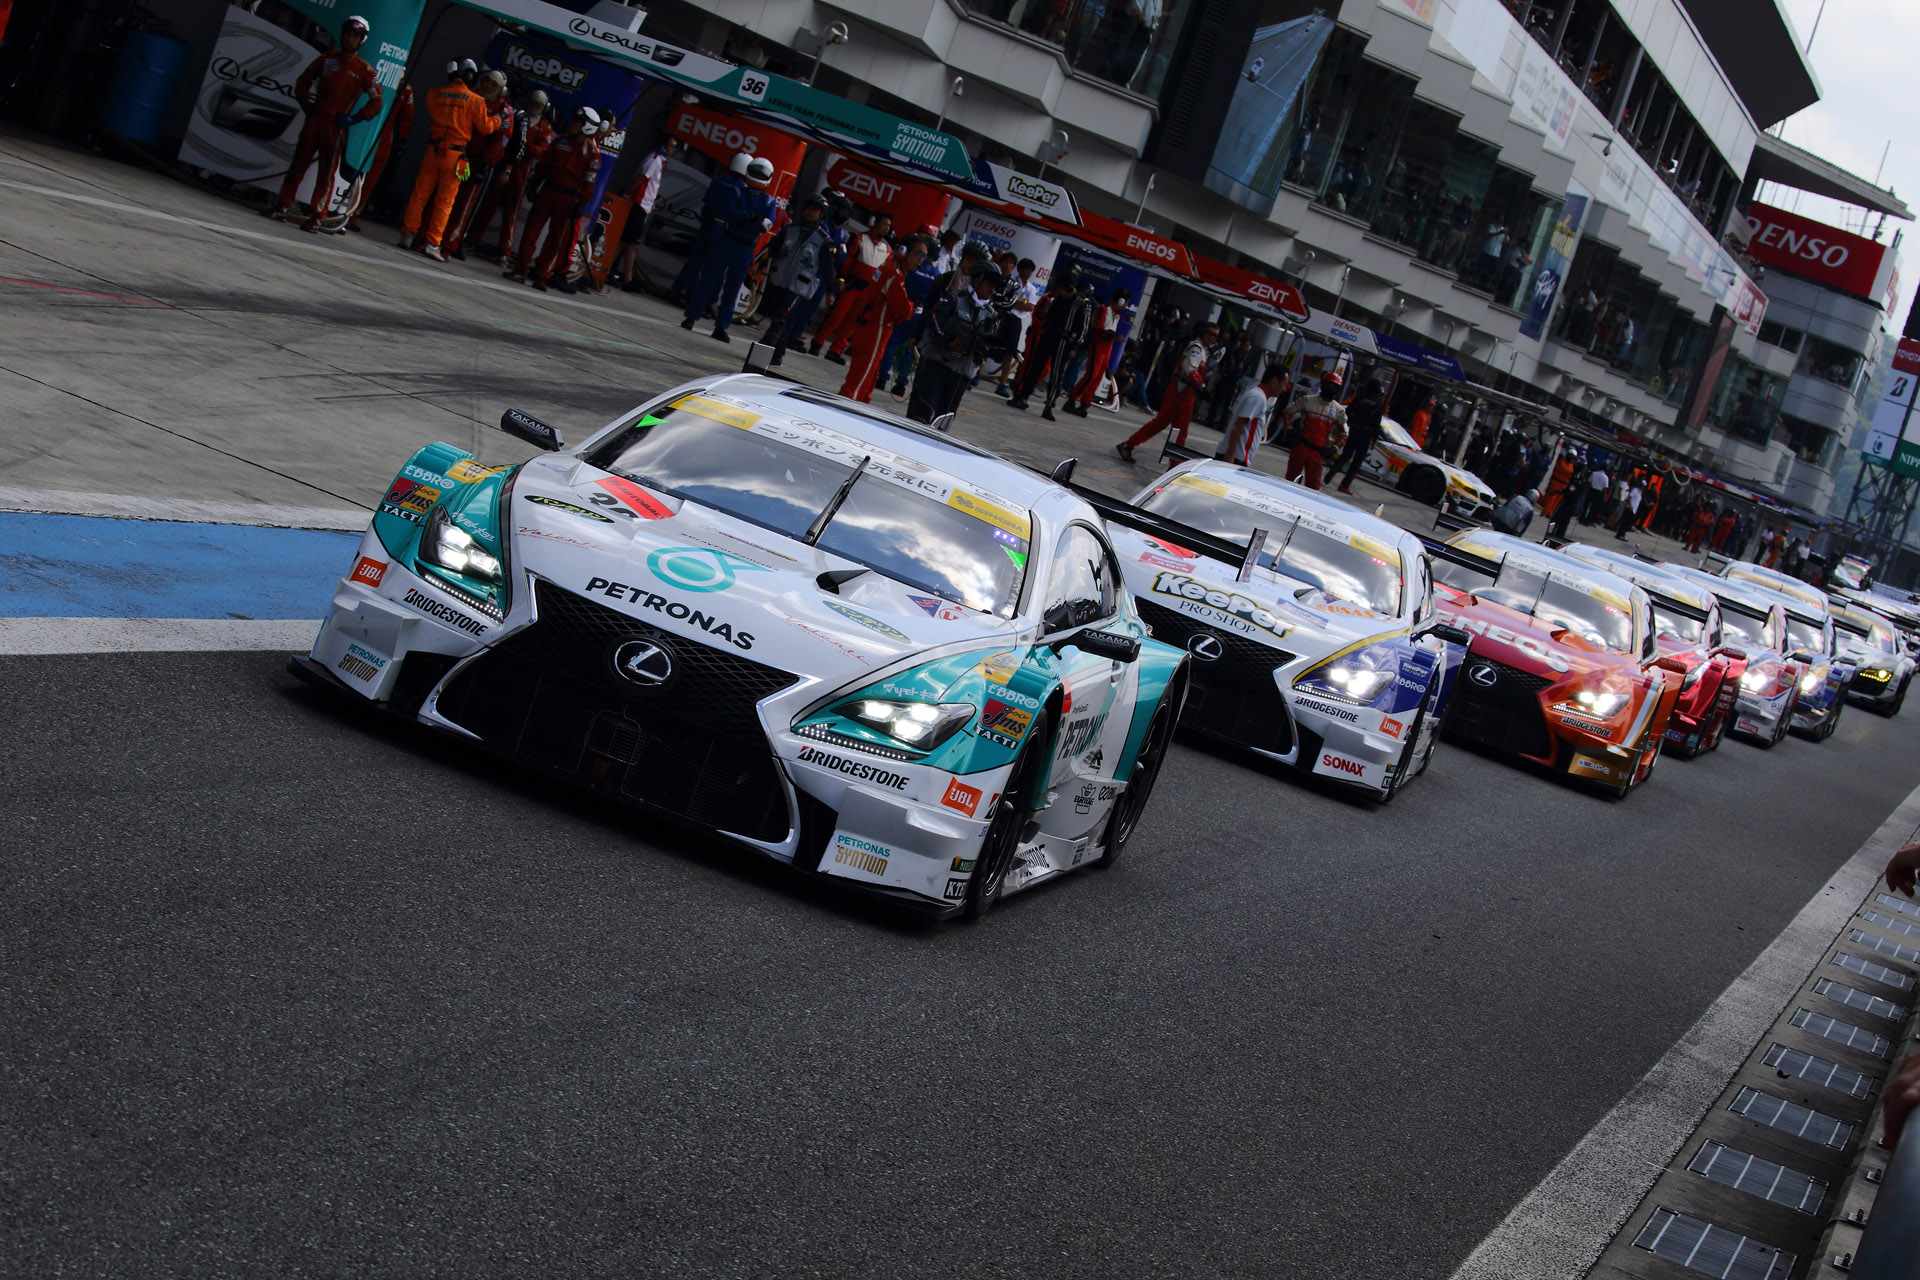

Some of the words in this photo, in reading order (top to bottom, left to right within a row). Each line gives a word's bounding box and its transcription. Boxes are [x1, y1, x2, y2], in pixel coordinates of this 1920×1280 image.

[592, 27, 650, 55] LEXUS
[504, 43, 588, 88] KeePer
[742, 78, 766, 95] 36
[677, 113, 759, 154] ENEOS
[897, 123, 949, 146] PETRONAS
[892, 133, 947, 164] SYNTIUM
[838, 168, 902, 204] ZENT
[1008, 176, 1060, 206] KeePer
[969, 229, 1011, 250] KOBELCO
[974, 218, 1016, 238] DENSO
[1126, 234, 1176, 261] ENEOS
[1248, 280, 1290, 304] ZENT
[1333, 319, 1360, 334] DENSO
[510, 411, 550, 436] TAKAMA
[404, 464, 455, 489] EBBRO
[359, 563, 382, 581] JBL
[403, 588, 489, 637] BRIDGESTONE
[585, 576, 756, 650] PETRONAS
[1153, 572, 1298, 638] KeePer
[1179, 600, 1212, 617] PRO
[1213, 611, 1257, 634] SHOP
[1084, 630, 1131, 647] TAKAMA
[348, 644, 387, 668] PETRONAS
[987, 684, 1039, 709] EBBRO
[1294, 695, 1359, 723] BRIDGESTONE
[975, 724, 1017, 749] TACTI
[1383, 720, 1398, 734] JBL
[1562, 716, 1611, 737] BRIDGESTONE
[797, 745, 910, 790] BRIDGESTONE
[1322, 754, 1365, 777] SONAX
[949, 787, 974, 808] JBL
[838, 834, 890, 858] PETRONAS
[835, 846, 889, 877] SYNTIUM
